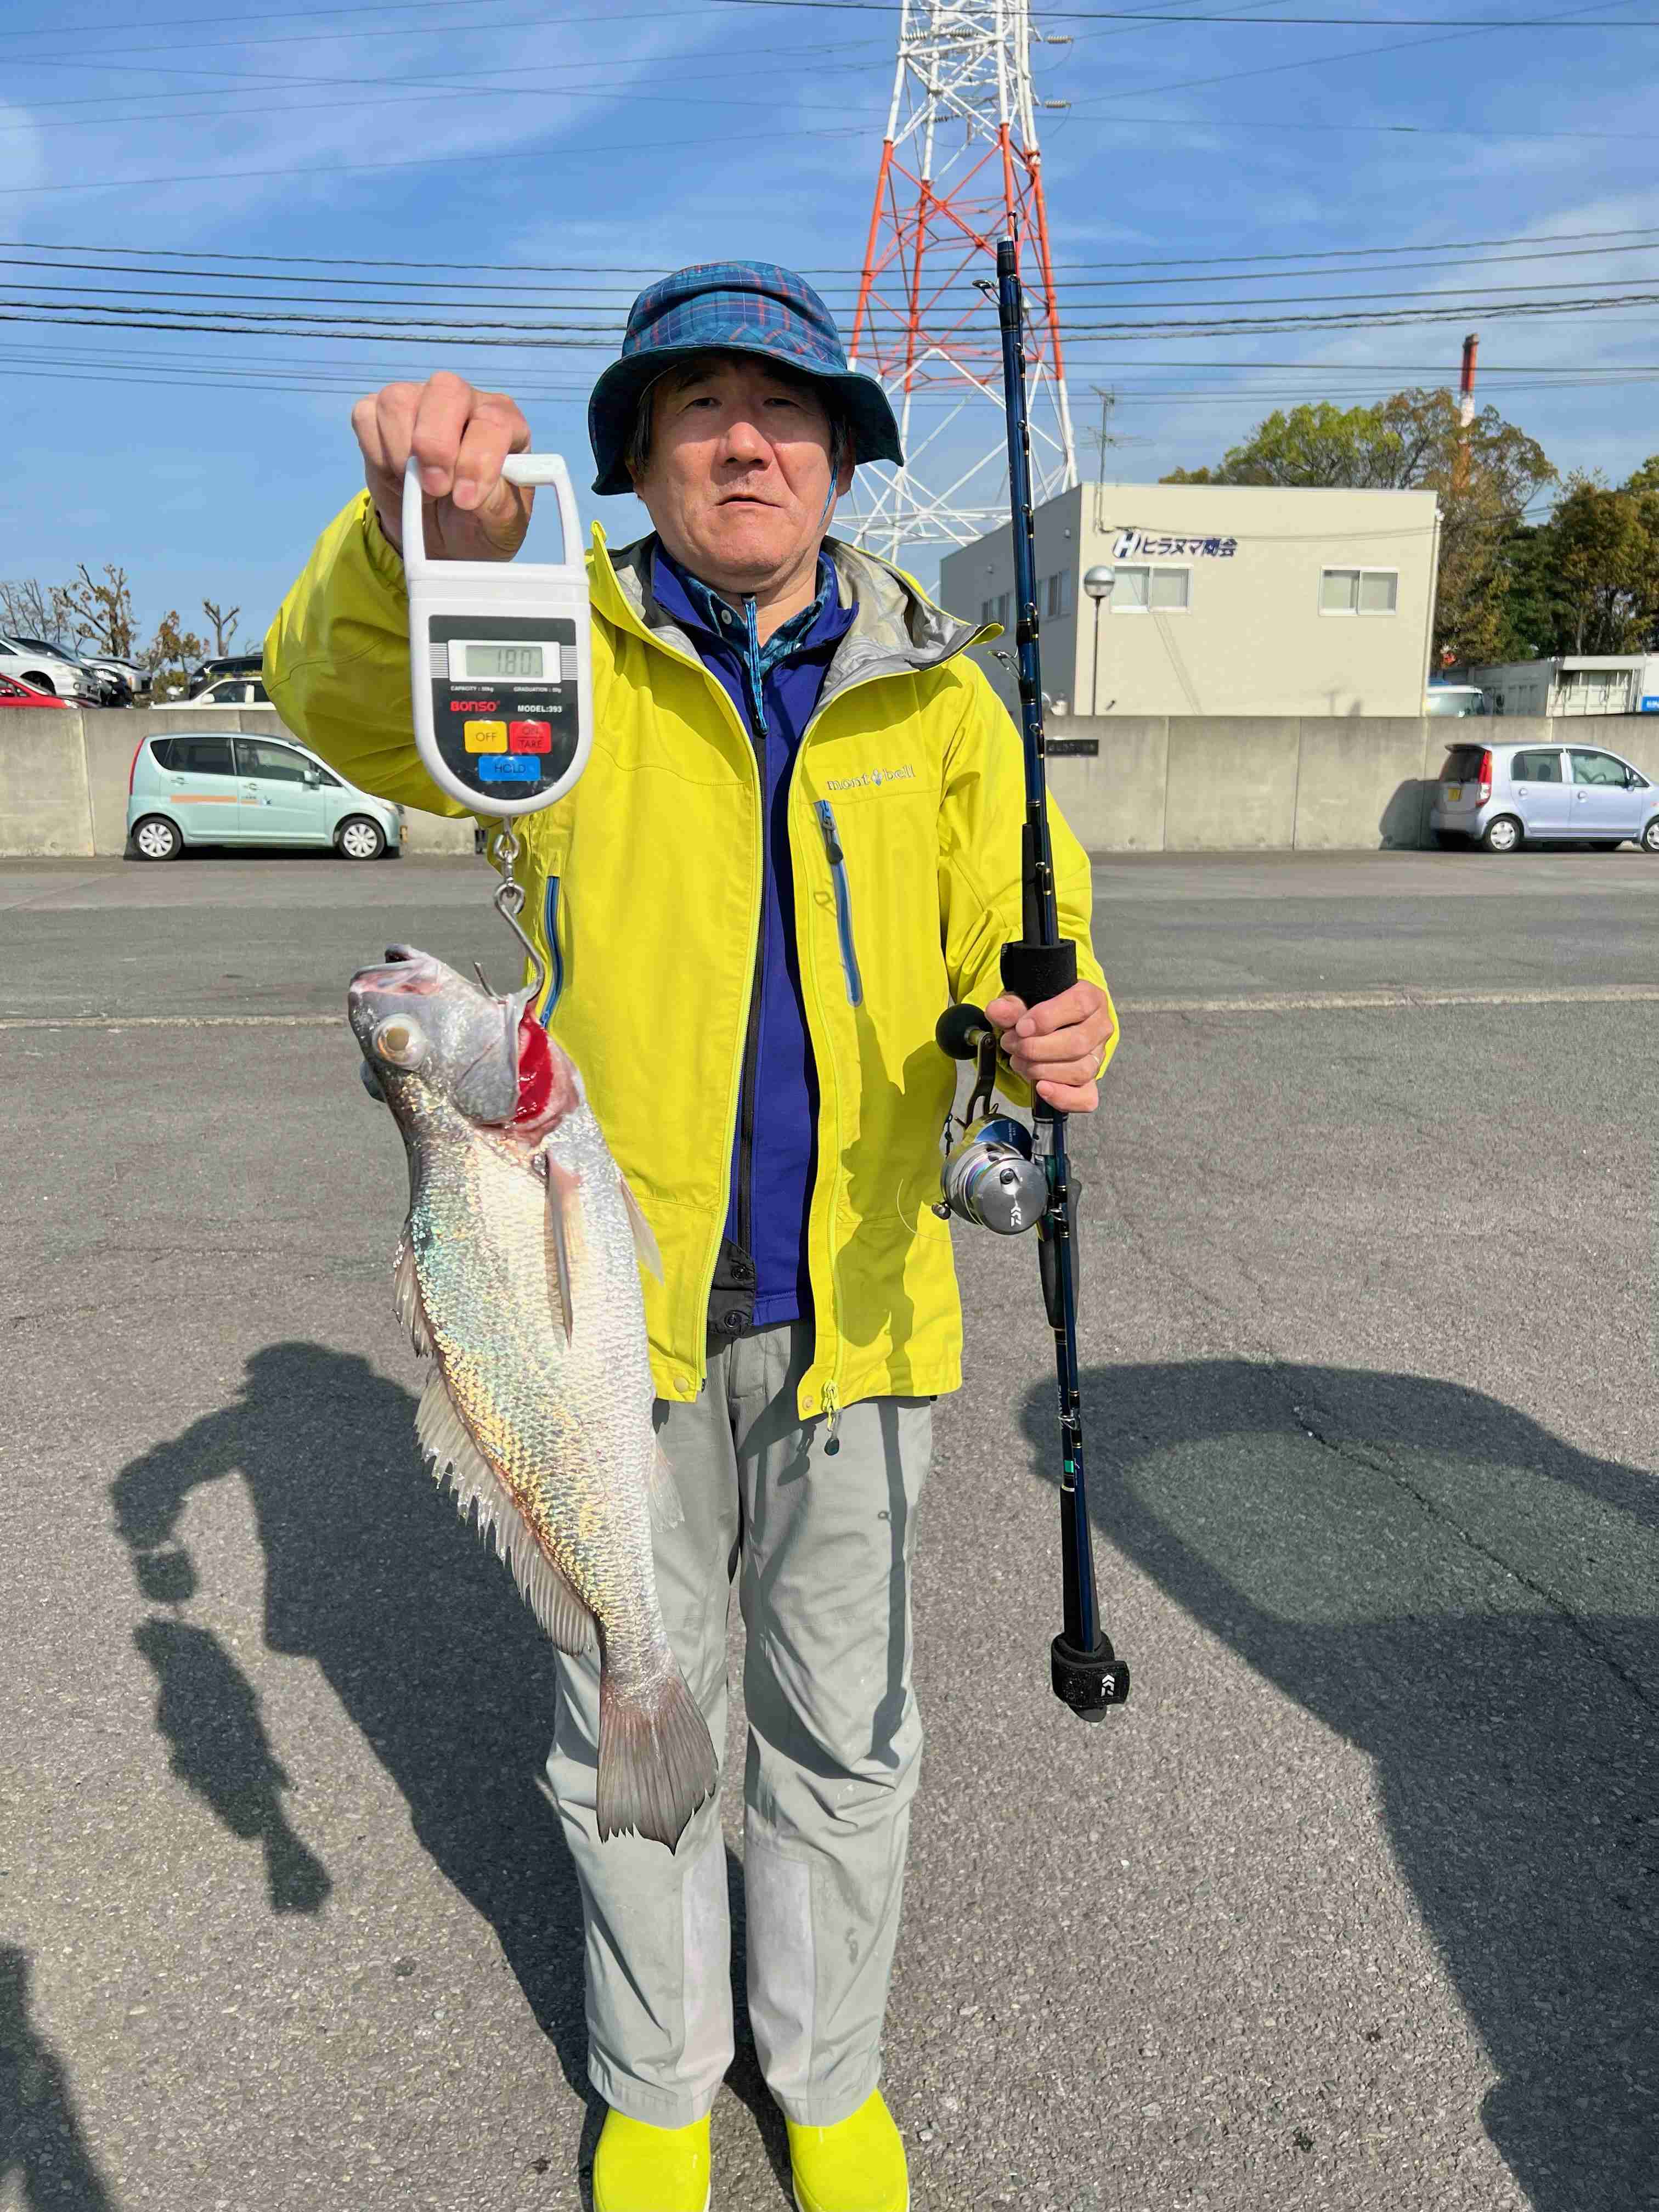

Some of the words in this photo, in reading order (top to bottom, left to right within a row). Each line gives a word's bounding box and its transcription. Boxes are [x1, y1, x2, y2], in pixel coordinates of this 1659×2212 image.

[1142, 536, 1238, 557] ヒラヌマ商会
[522, 726, 539, 735] ON
[476, 732, 497, 742] OFF
[495, 764, 526, 773] HOLD
[827, 772, 870, 790] mont
[883, 763, 916, 782] bell
